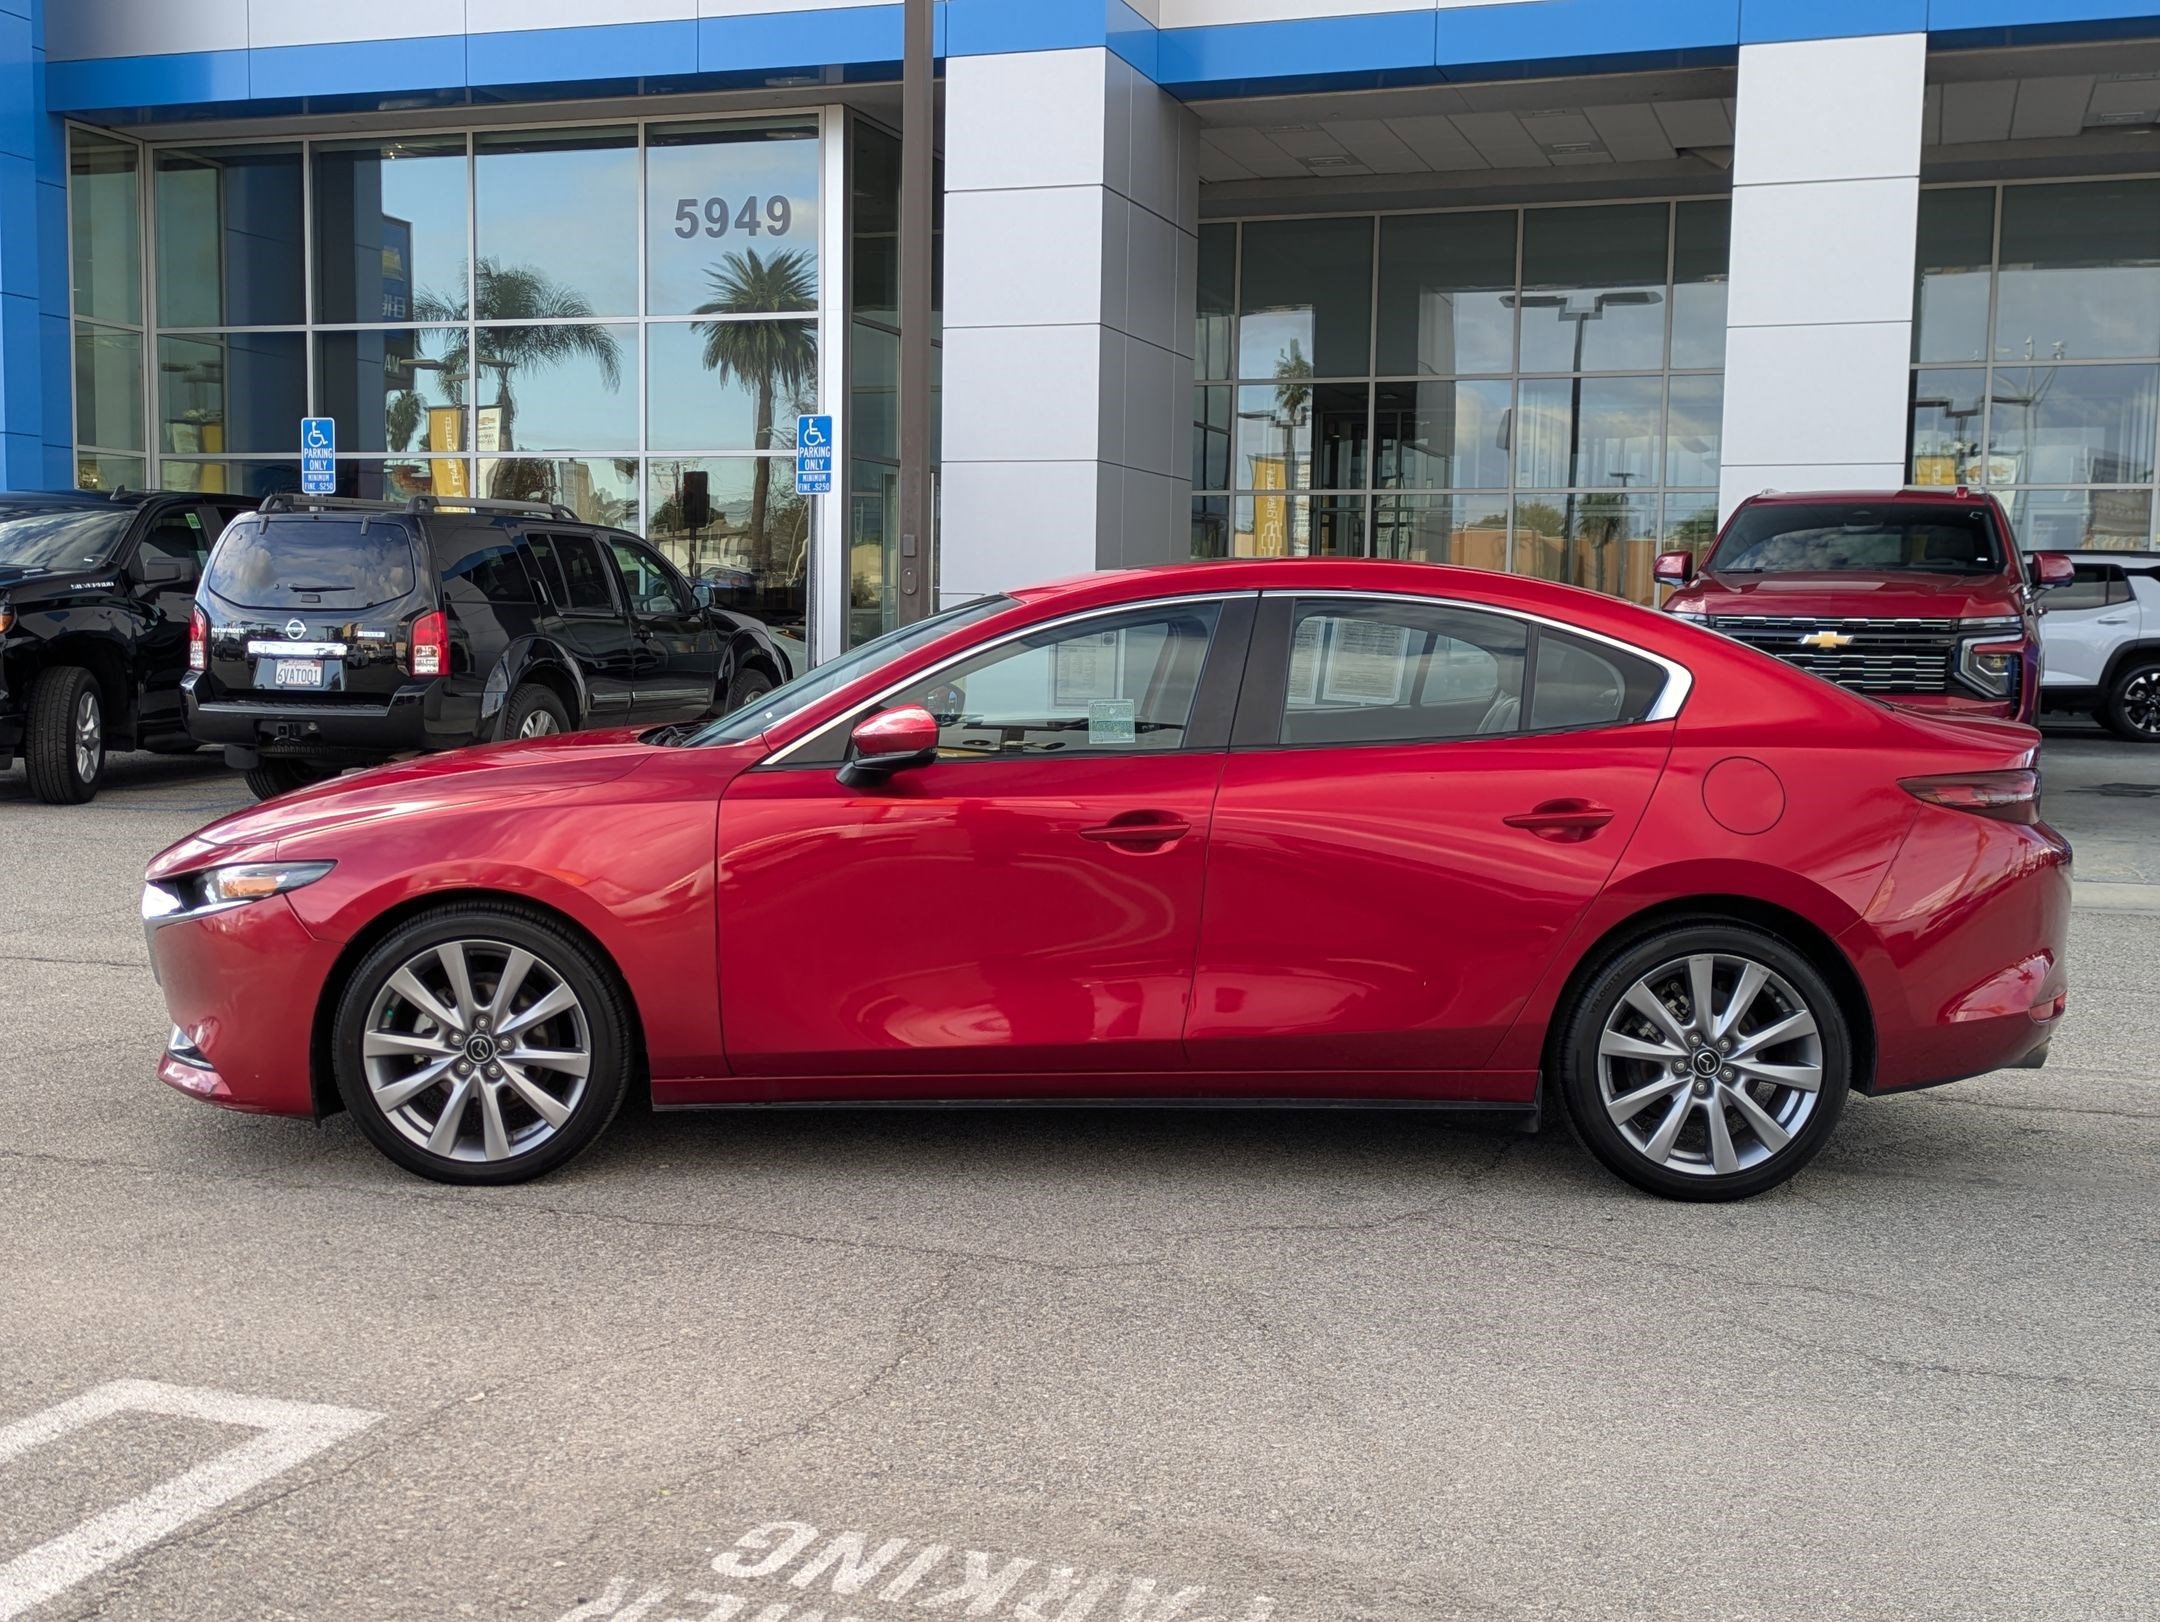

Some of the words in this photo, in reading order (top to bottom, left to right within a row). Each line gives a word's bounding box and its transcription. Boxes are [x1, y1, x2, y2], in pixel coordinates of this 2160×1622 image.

[674, 195, 792, 239] 5949
[304, 448, 333, 459] PARKING
[799, 446, 831, 458] PARKING
[309, 459, 328, 471] ONLY
[804, 459, 825, 471] ONLY
[802, 474, 827, 482] MINIMUM
[304, 482, 316, 490] FINE
[798, 483, 811, 491] FINE
[277, 668, 320, 683] 6VAT001
